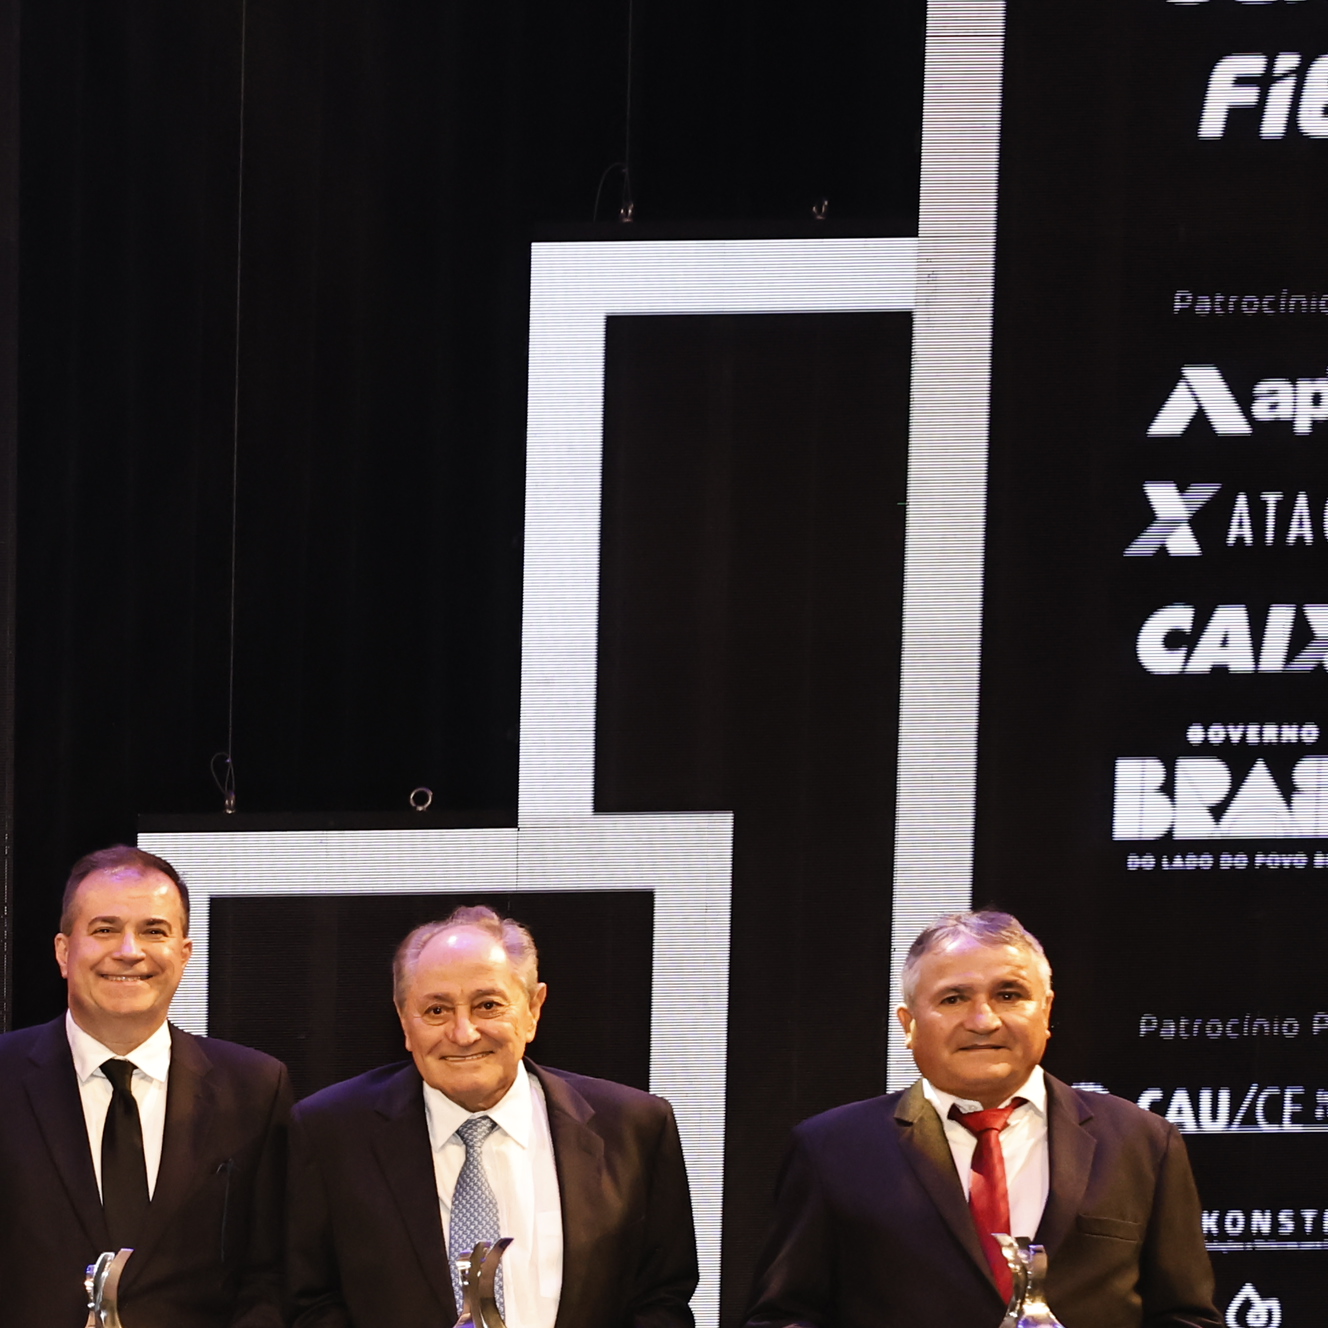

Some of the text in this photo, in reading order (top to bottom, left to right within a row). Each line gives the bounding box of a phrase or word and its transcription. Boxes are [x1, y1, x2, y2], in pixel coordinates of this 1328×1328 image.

[1250, 366, 1328, 435] ap
[1225, 491, 1328, 546] ATA
[1186, 722, 1319, 746] GOVERNO
[1162, 853, 1213, 870] LADO
[1139, 1013, 1300, 1039] Patrocínio
